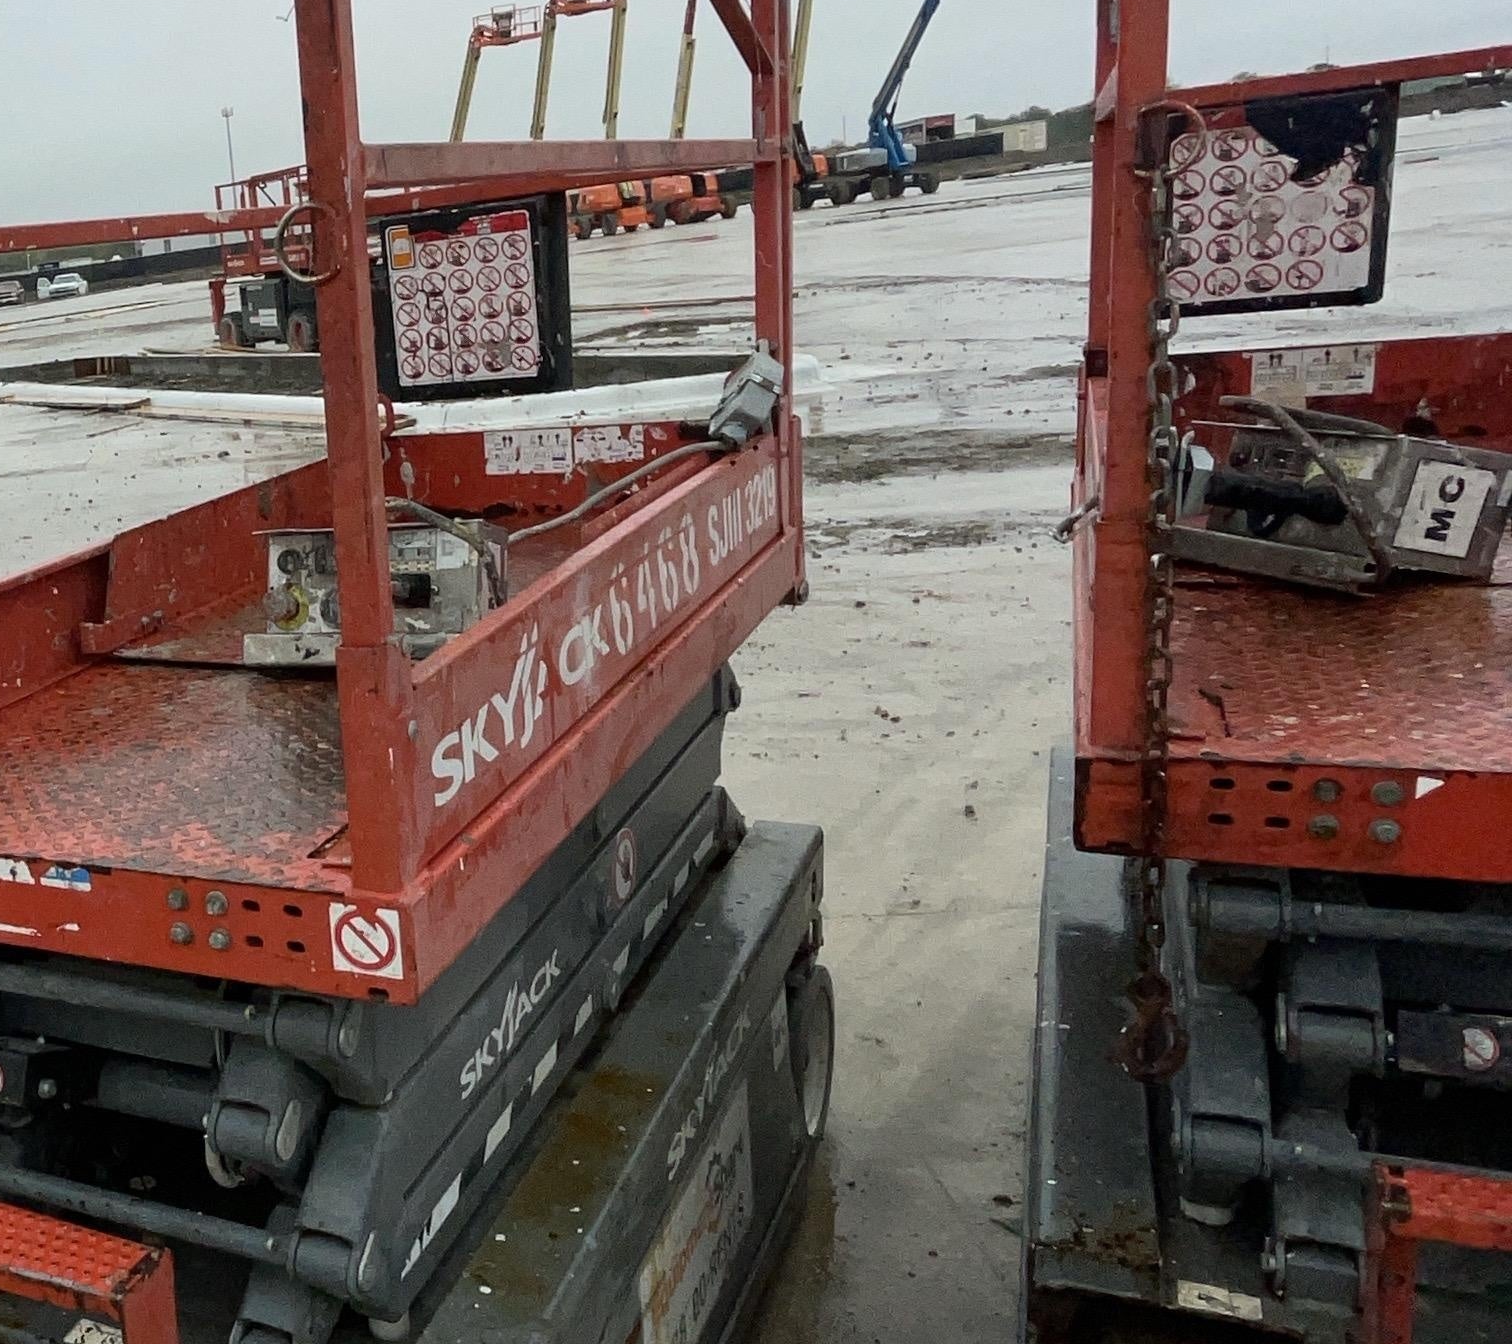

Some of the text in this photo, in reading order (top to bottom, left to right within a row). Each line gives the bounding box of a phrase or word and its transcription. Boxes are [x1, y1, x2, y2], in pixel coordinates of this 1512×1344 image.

[744, 463, 777, 535] 3219
[1424, 475, 1465, 542] MC
[460, 948, 561, 1100] SKYJACK
